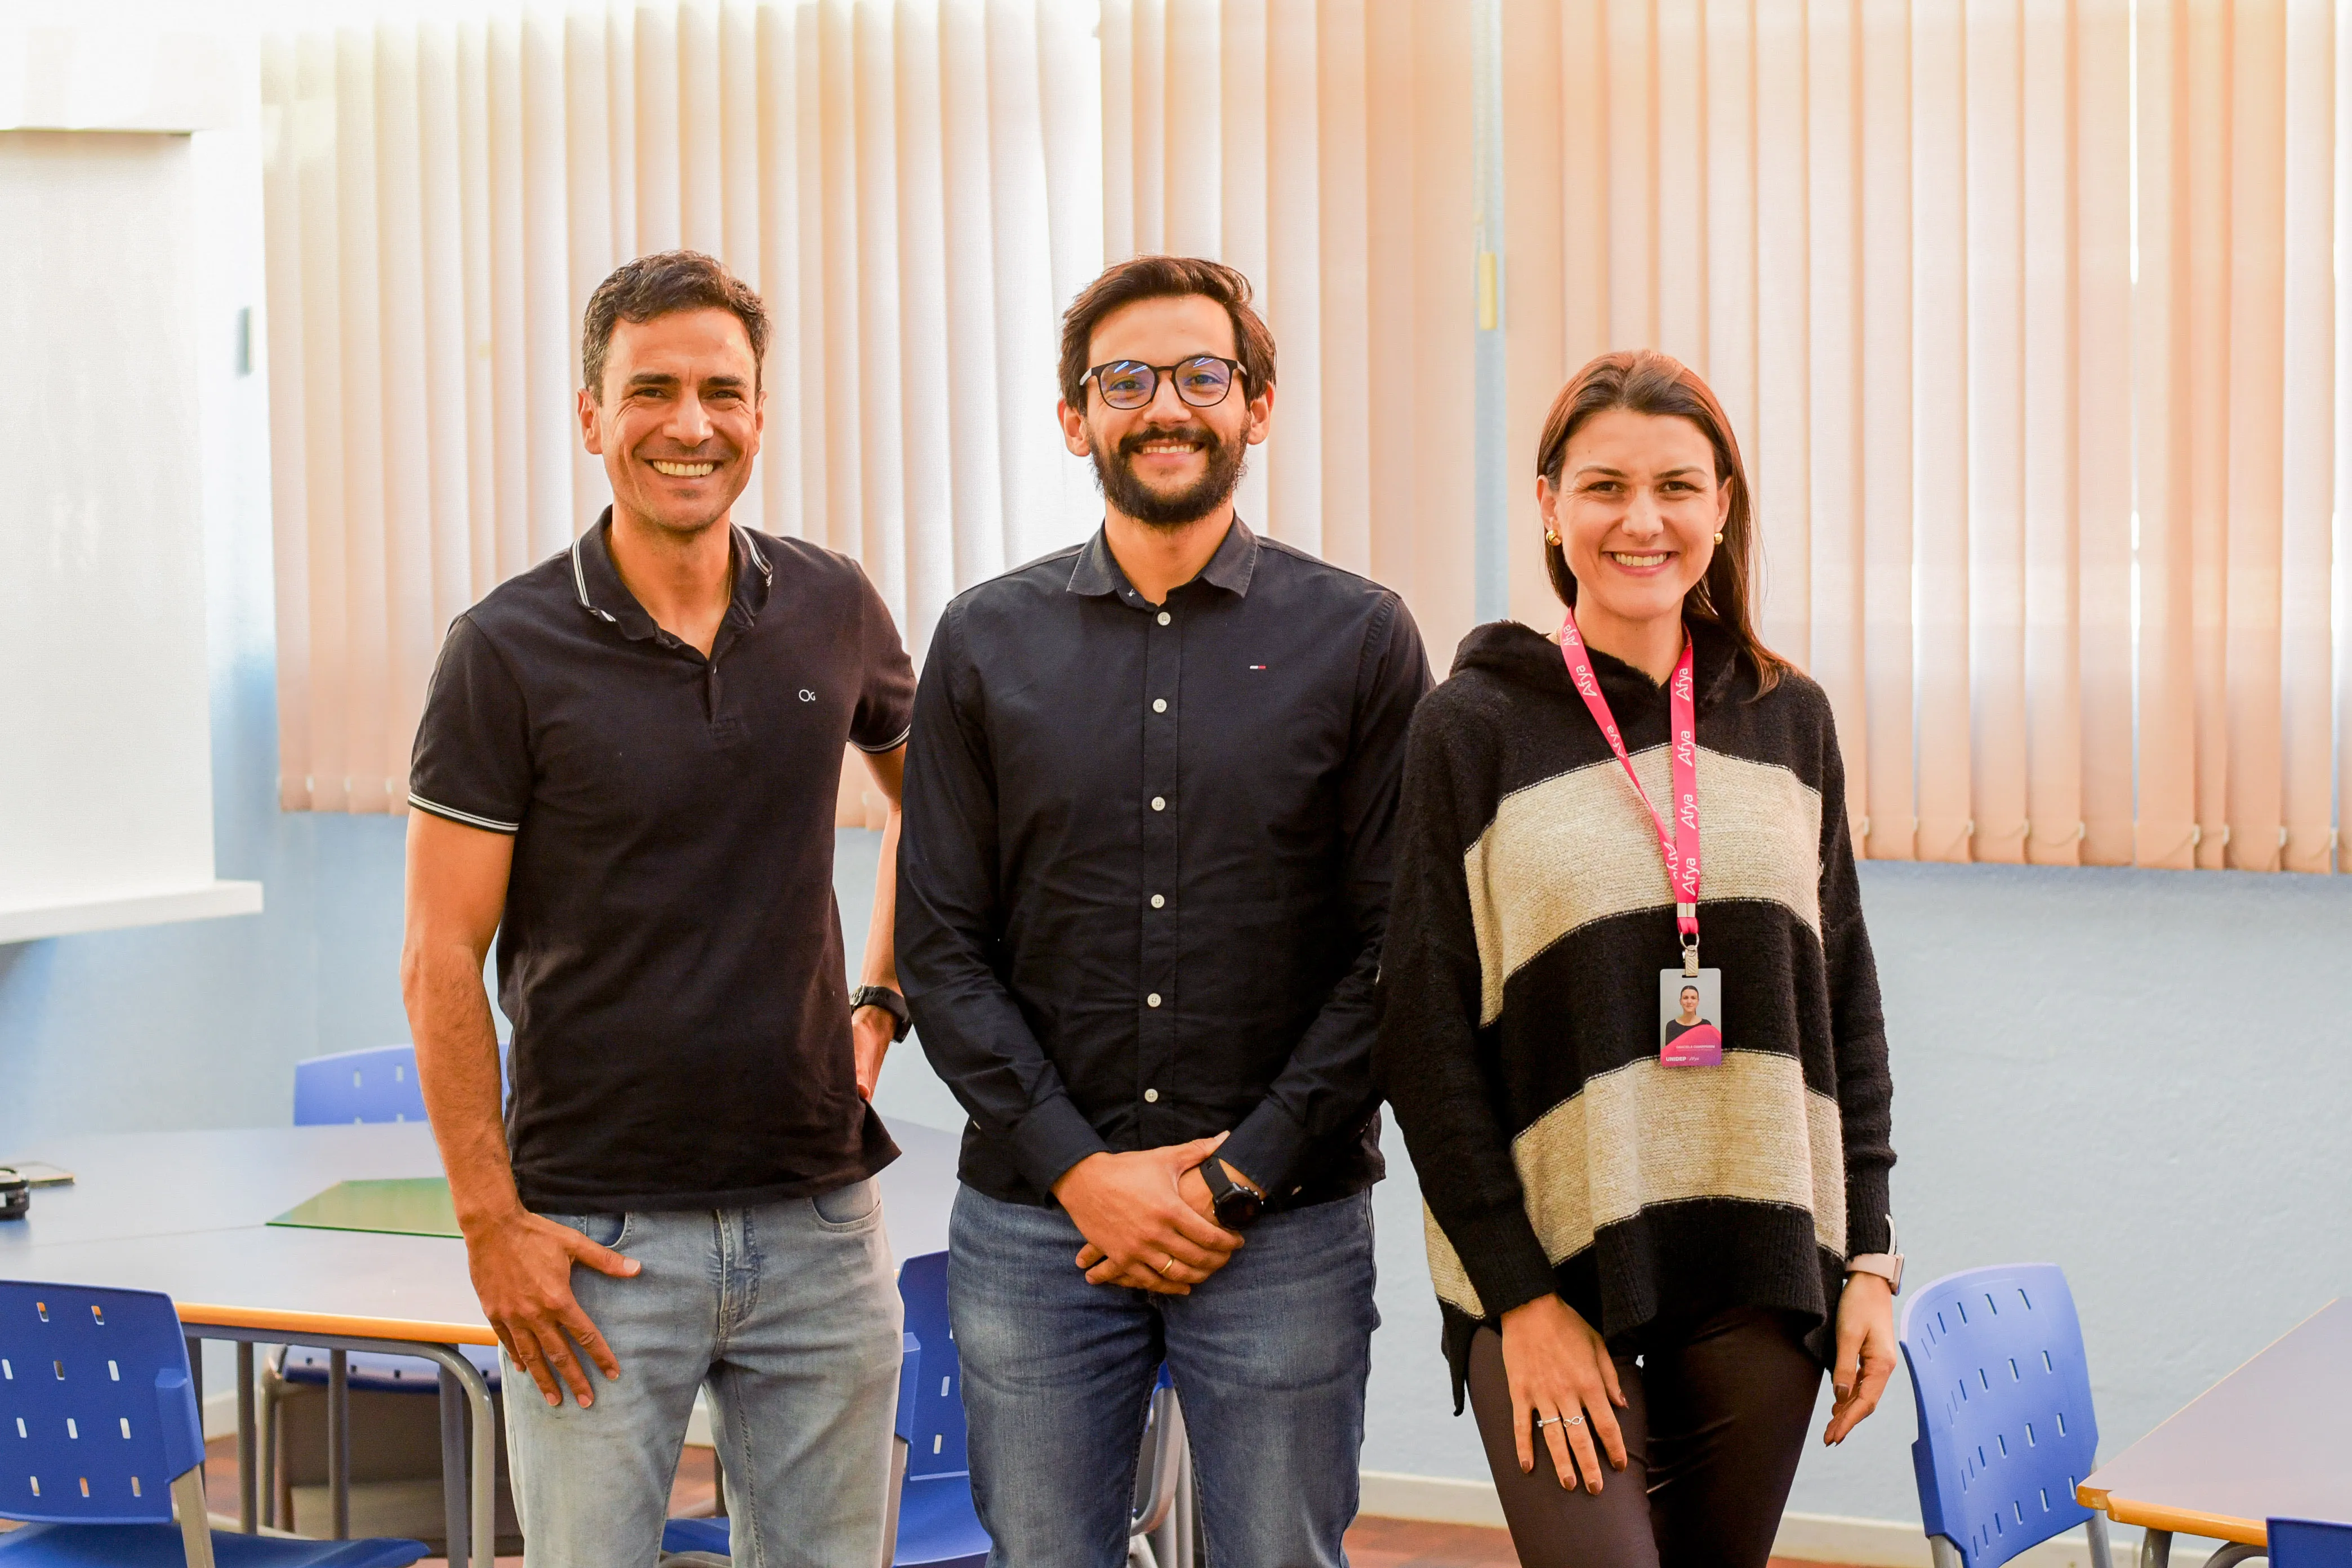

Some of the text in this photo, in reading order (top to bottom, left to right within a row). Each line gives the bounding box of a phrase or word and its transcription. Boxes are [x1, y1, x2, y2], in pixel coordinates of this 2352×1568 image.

[1575, 665, 1598, 697] Afya
[1675, 667, 1692, 702] Afya
[1606, 725, 1625, 759] Afya
[1677, 730, 1695, 767] Afya
[1681, 793, 1698, 830] Afya
[1682, 858, 1700, 896] Afya
